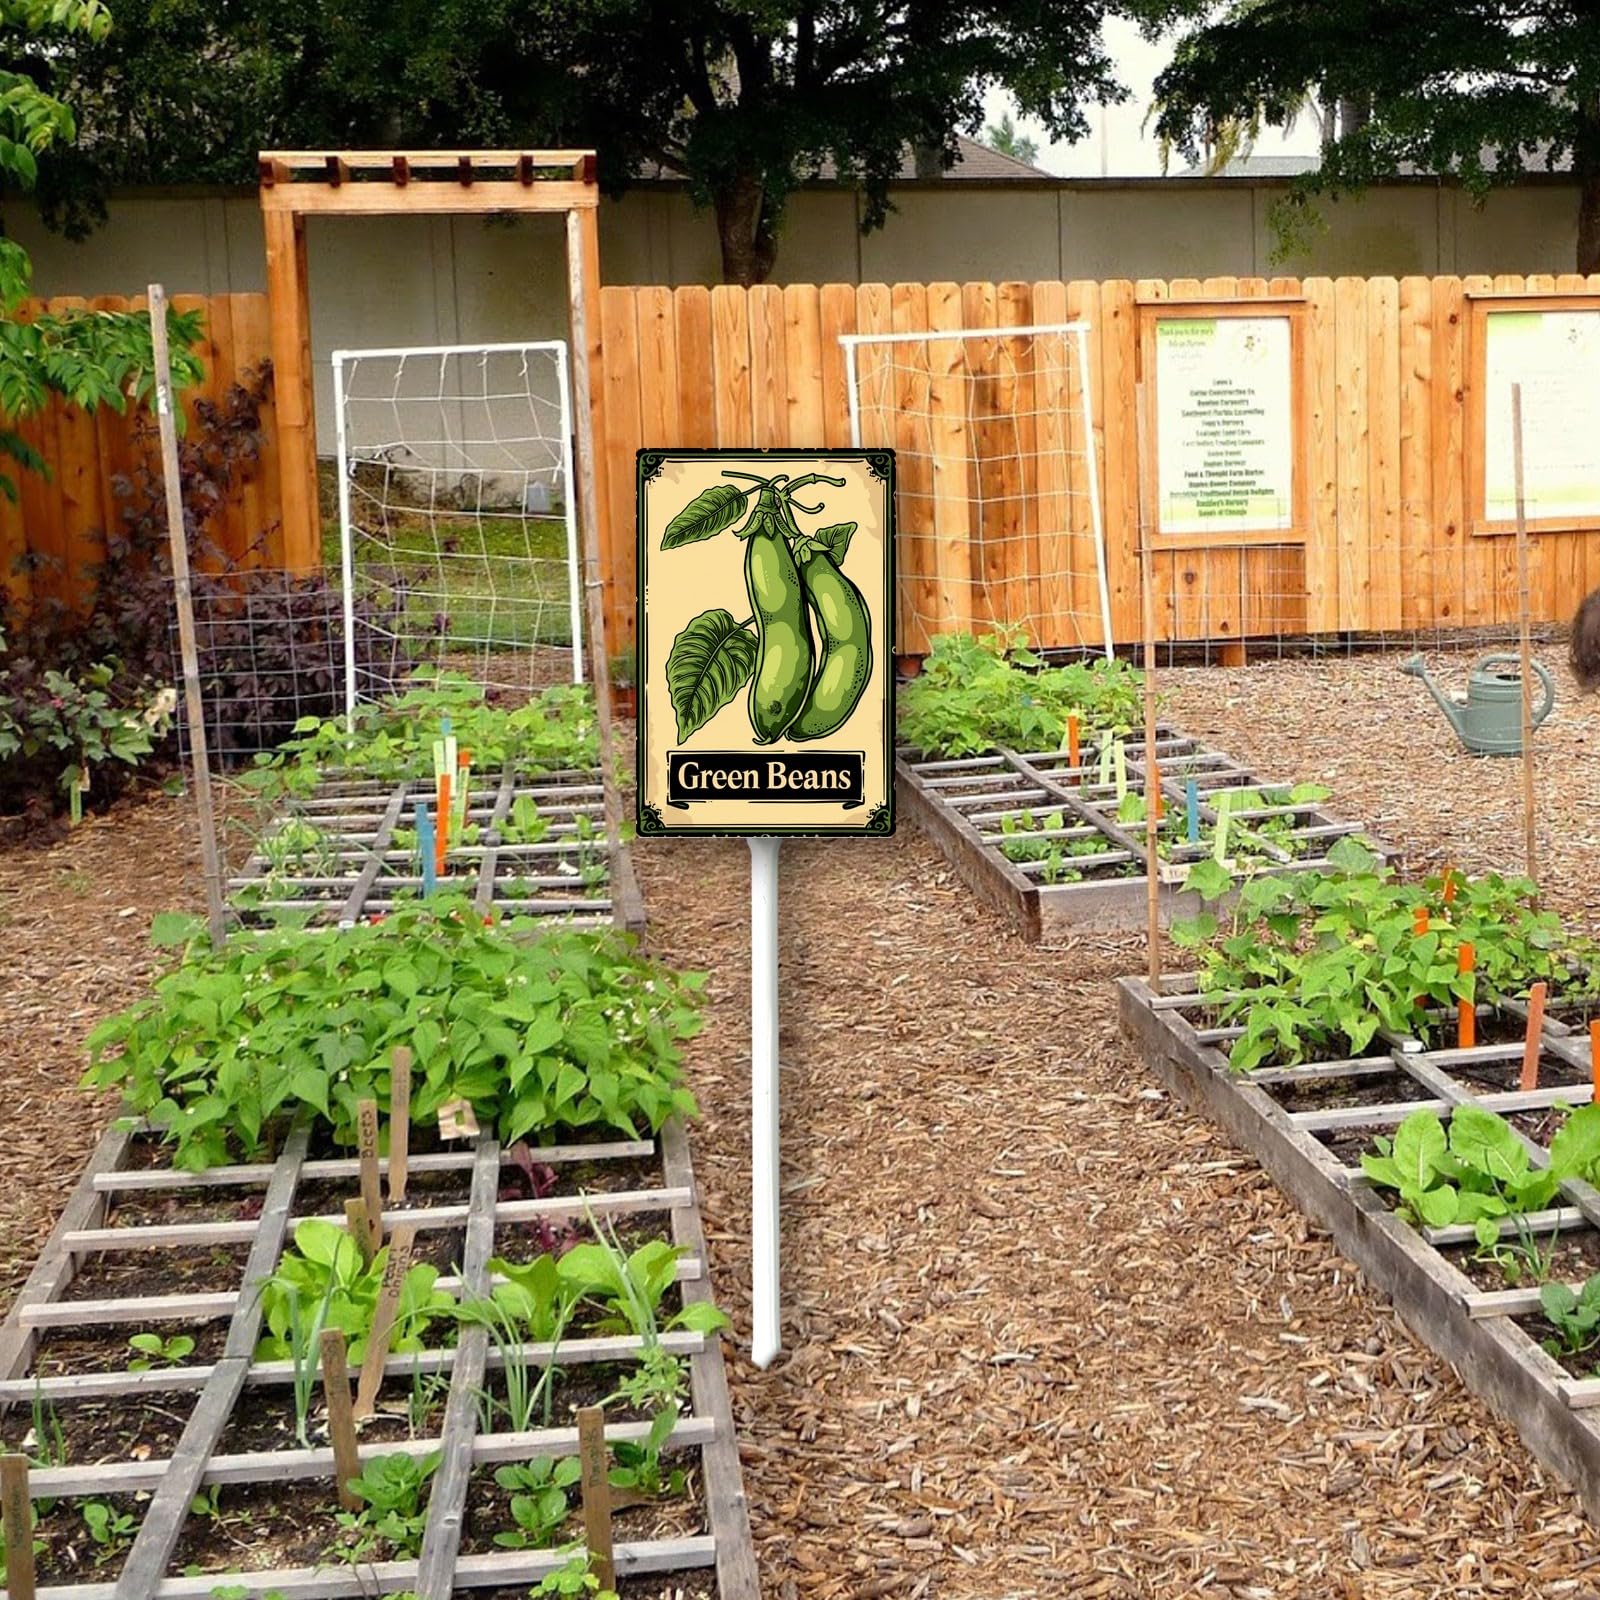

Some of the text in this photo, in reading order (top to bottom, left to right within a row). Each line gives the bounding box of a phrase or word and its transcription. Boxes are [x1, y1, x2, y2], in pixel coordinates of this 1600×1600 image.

[678, 761, 852, 790] Green Beans
[382, 1248, 398, 1288] Pearl
[388, 1245, 410, 1298] Onions
